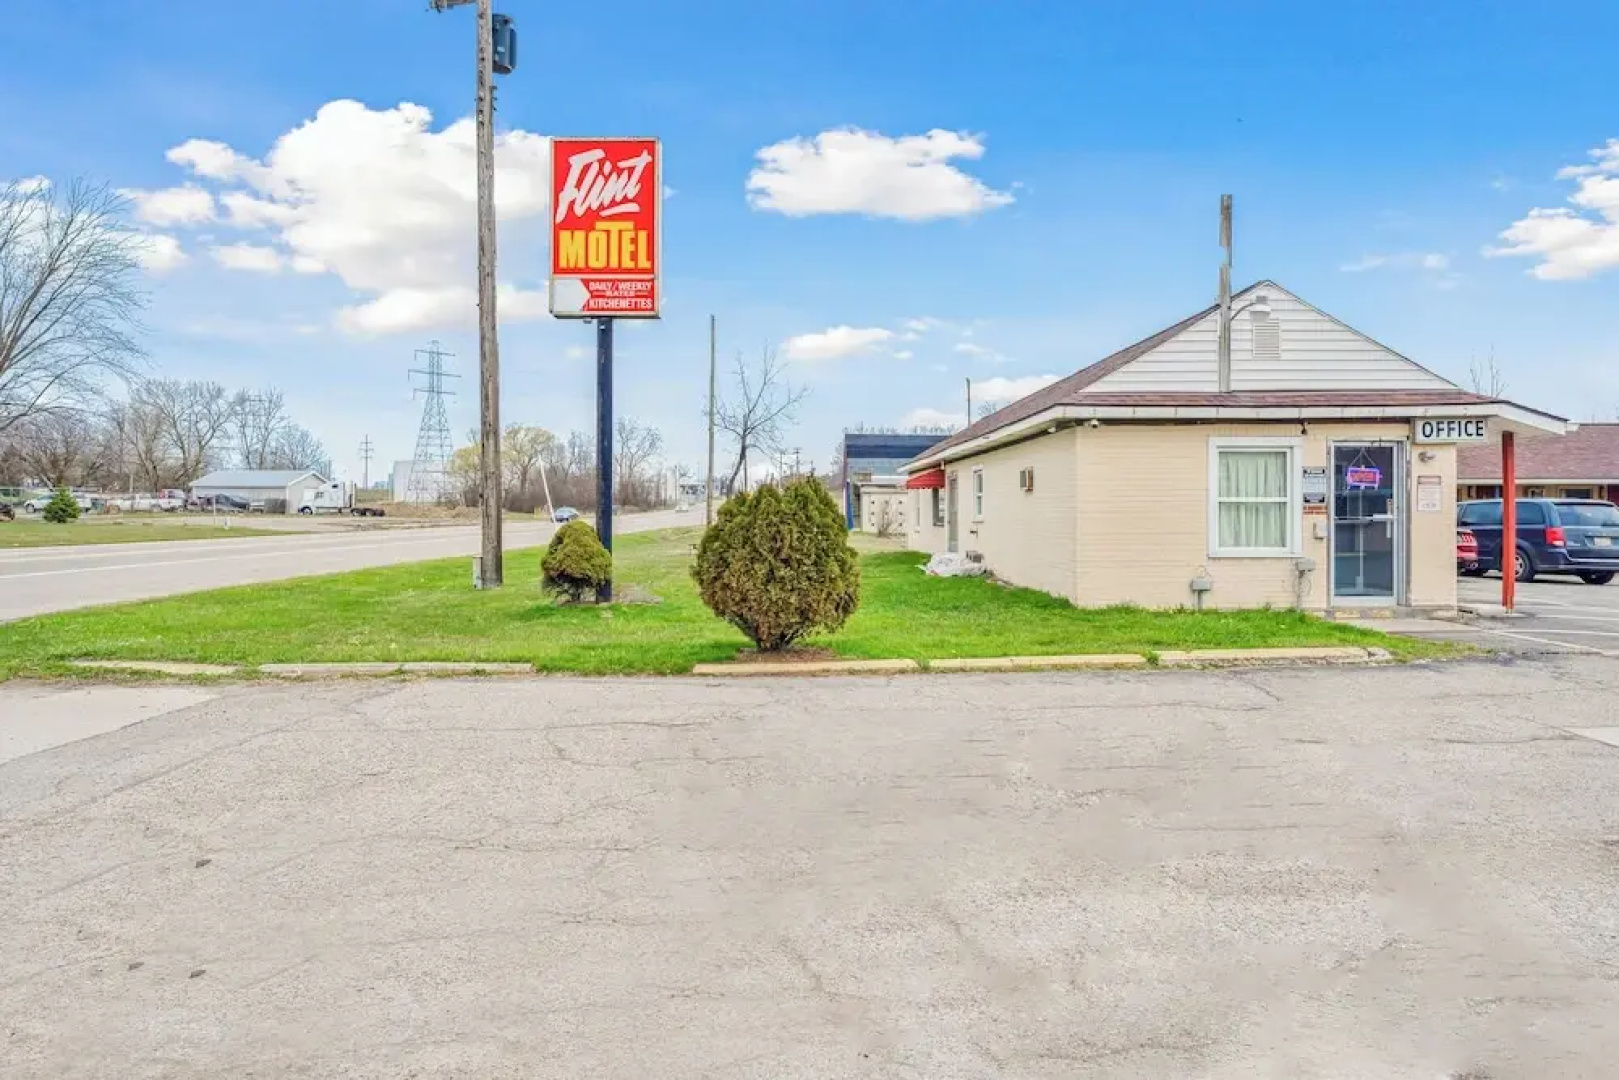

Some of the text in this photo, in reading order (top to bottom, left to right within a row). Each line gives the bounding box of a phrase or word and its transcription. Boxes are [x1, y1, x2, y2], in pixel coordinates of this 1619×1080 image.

[556, 148, 652, 224] Flint
[559, 221, 652, 269] MOTEL
[589, 298, 652, 309] KITCHENETTES
[1422, 420, 1484, 438] OFFICE
